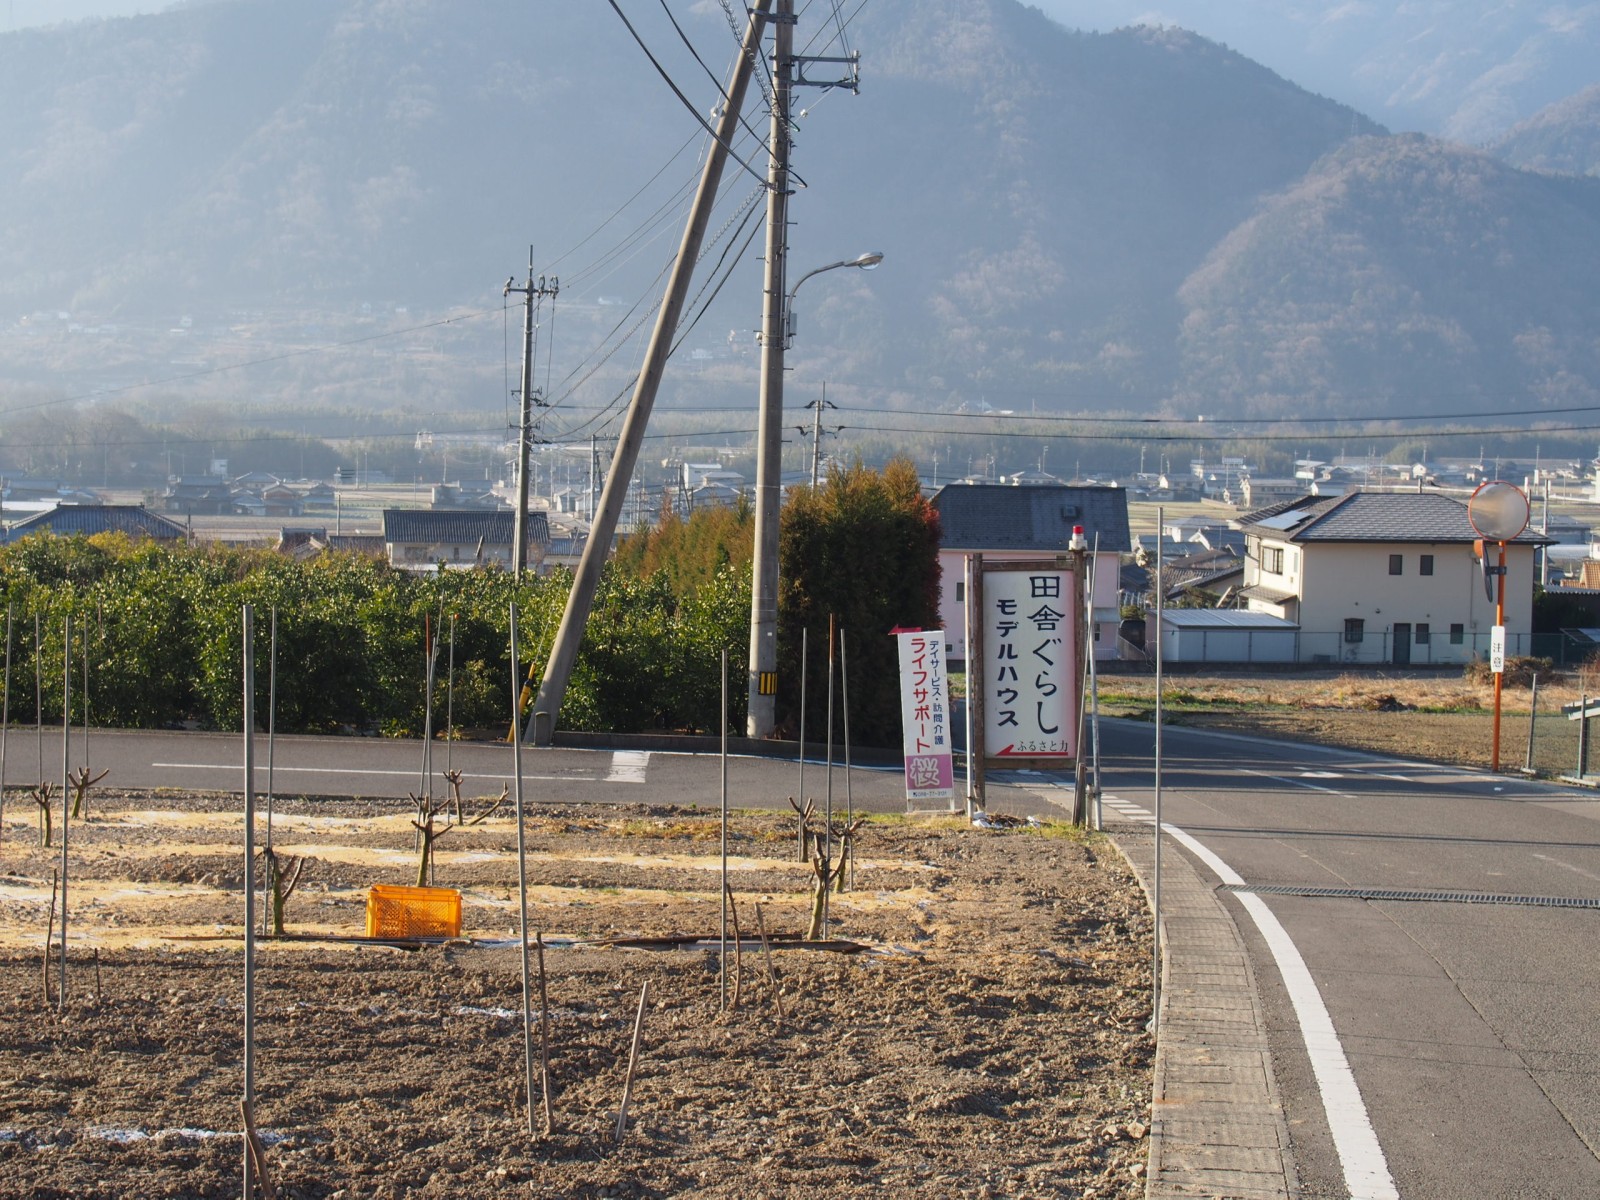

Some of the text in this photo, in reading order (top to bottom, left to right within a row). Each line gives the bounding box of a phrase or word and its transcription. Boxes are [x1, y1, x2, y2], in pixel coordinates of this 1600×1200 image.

[911, 638, 930, 753] ライフサポート
[929, 640, 944, 745] デイサービス・訪問介護
[996, 599, 1019, 727] モデルハウス
[1027, 575, 1066, 734] 田舎ぐらし
[911, 758, 940, 787] 桜
